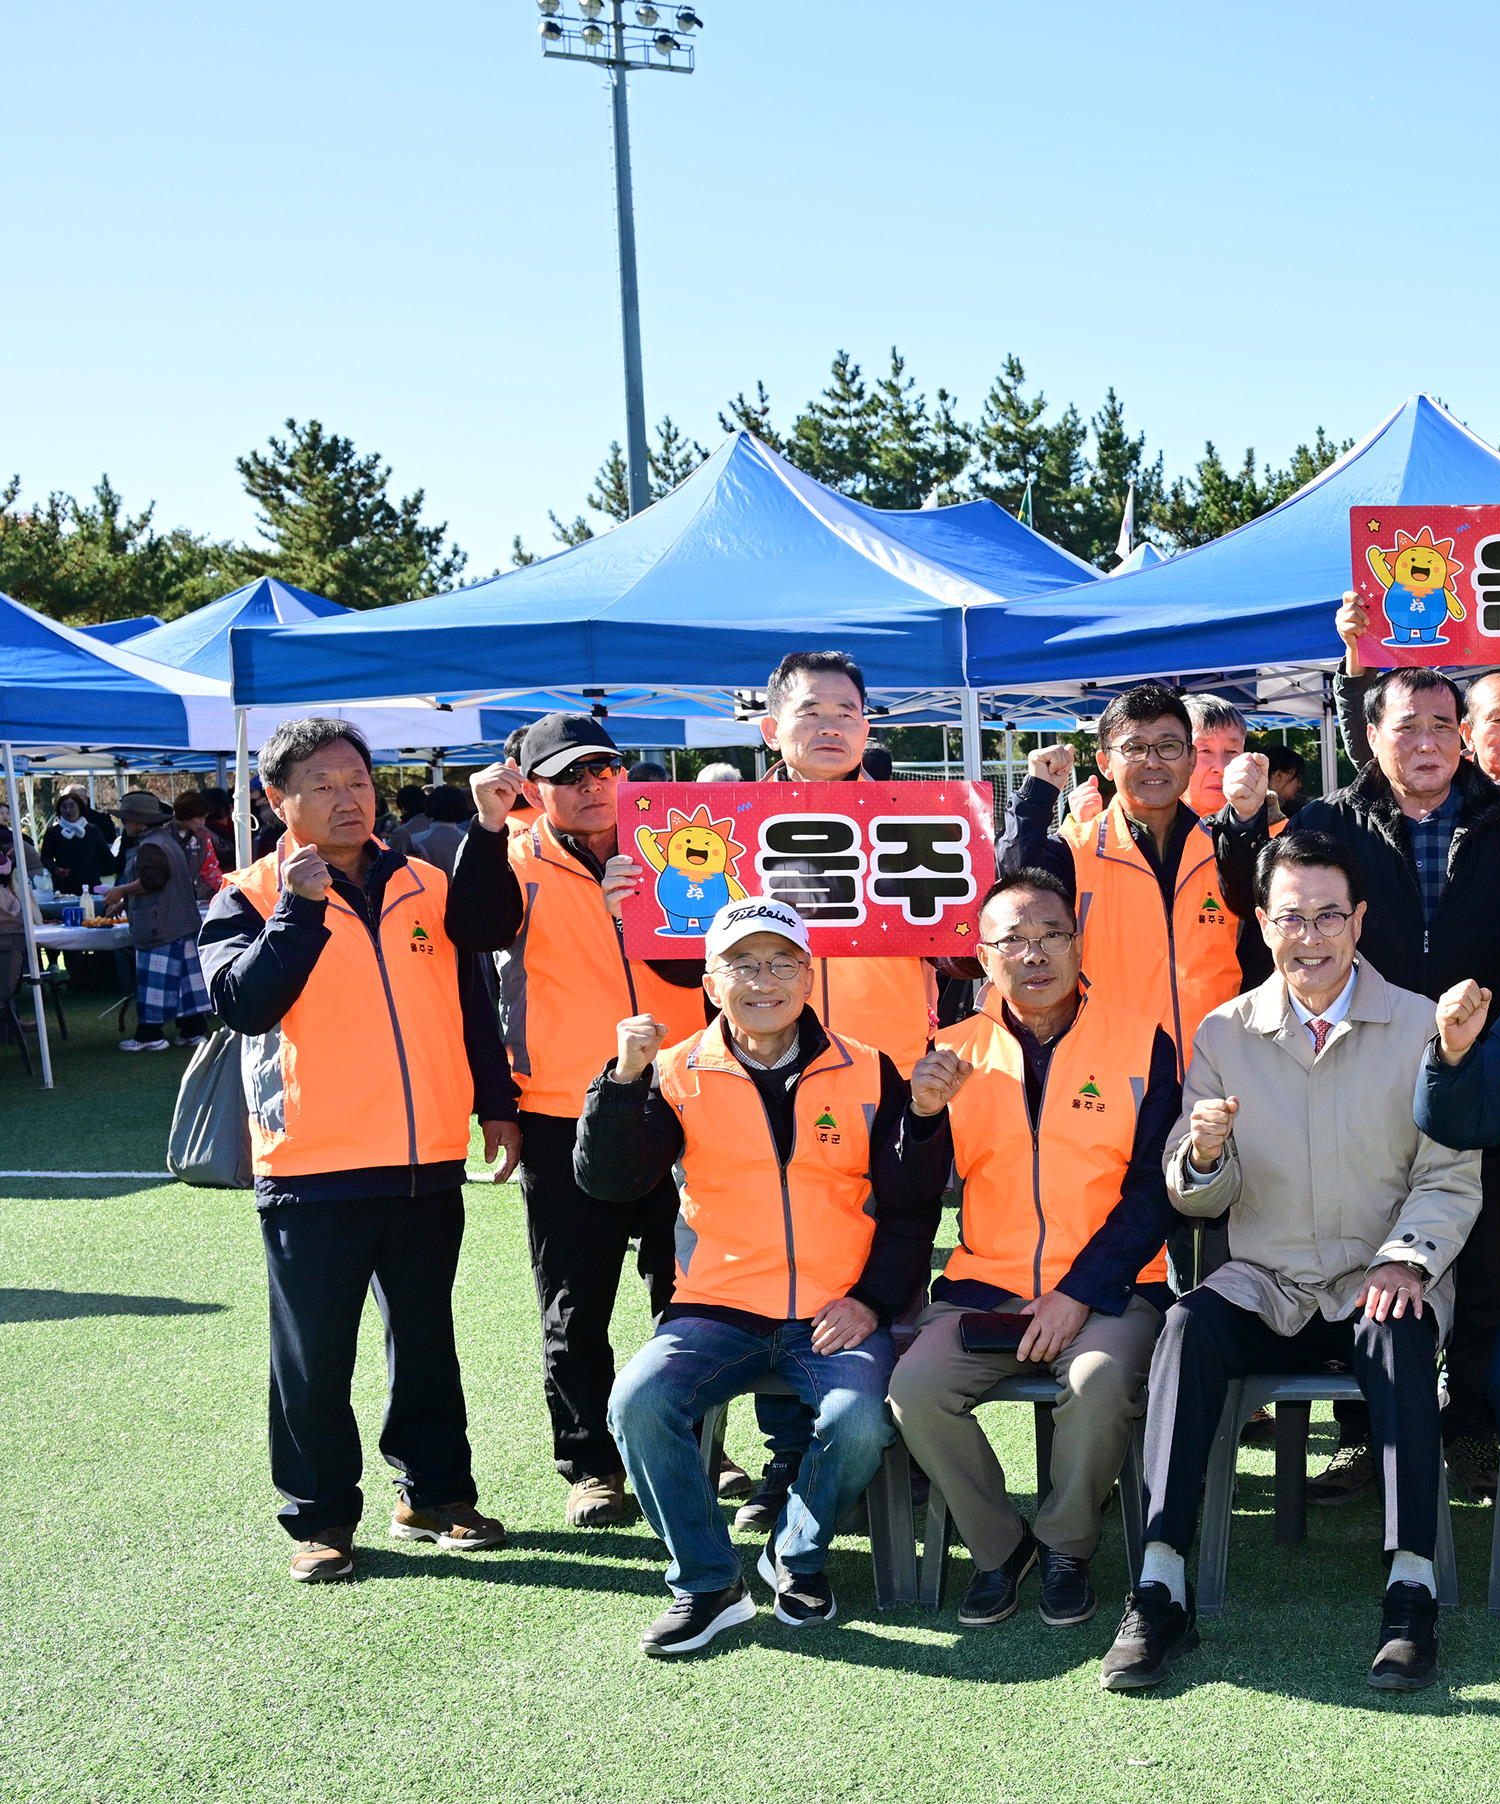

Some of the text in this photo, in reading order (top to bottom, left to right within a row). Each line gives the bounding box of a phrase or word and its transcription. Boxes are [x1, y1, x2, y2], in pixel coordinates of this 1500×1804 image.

[758, 817, 973, 923] 울주
[722, 904, 797, 931] Titleist
[1198, 914, 1226, 925] 울주군
[410, 942, 434, 956] 울주군
[1071, 1098, 1106, 1113] 울주군
[815, 1132, 841, 1145] 주군
